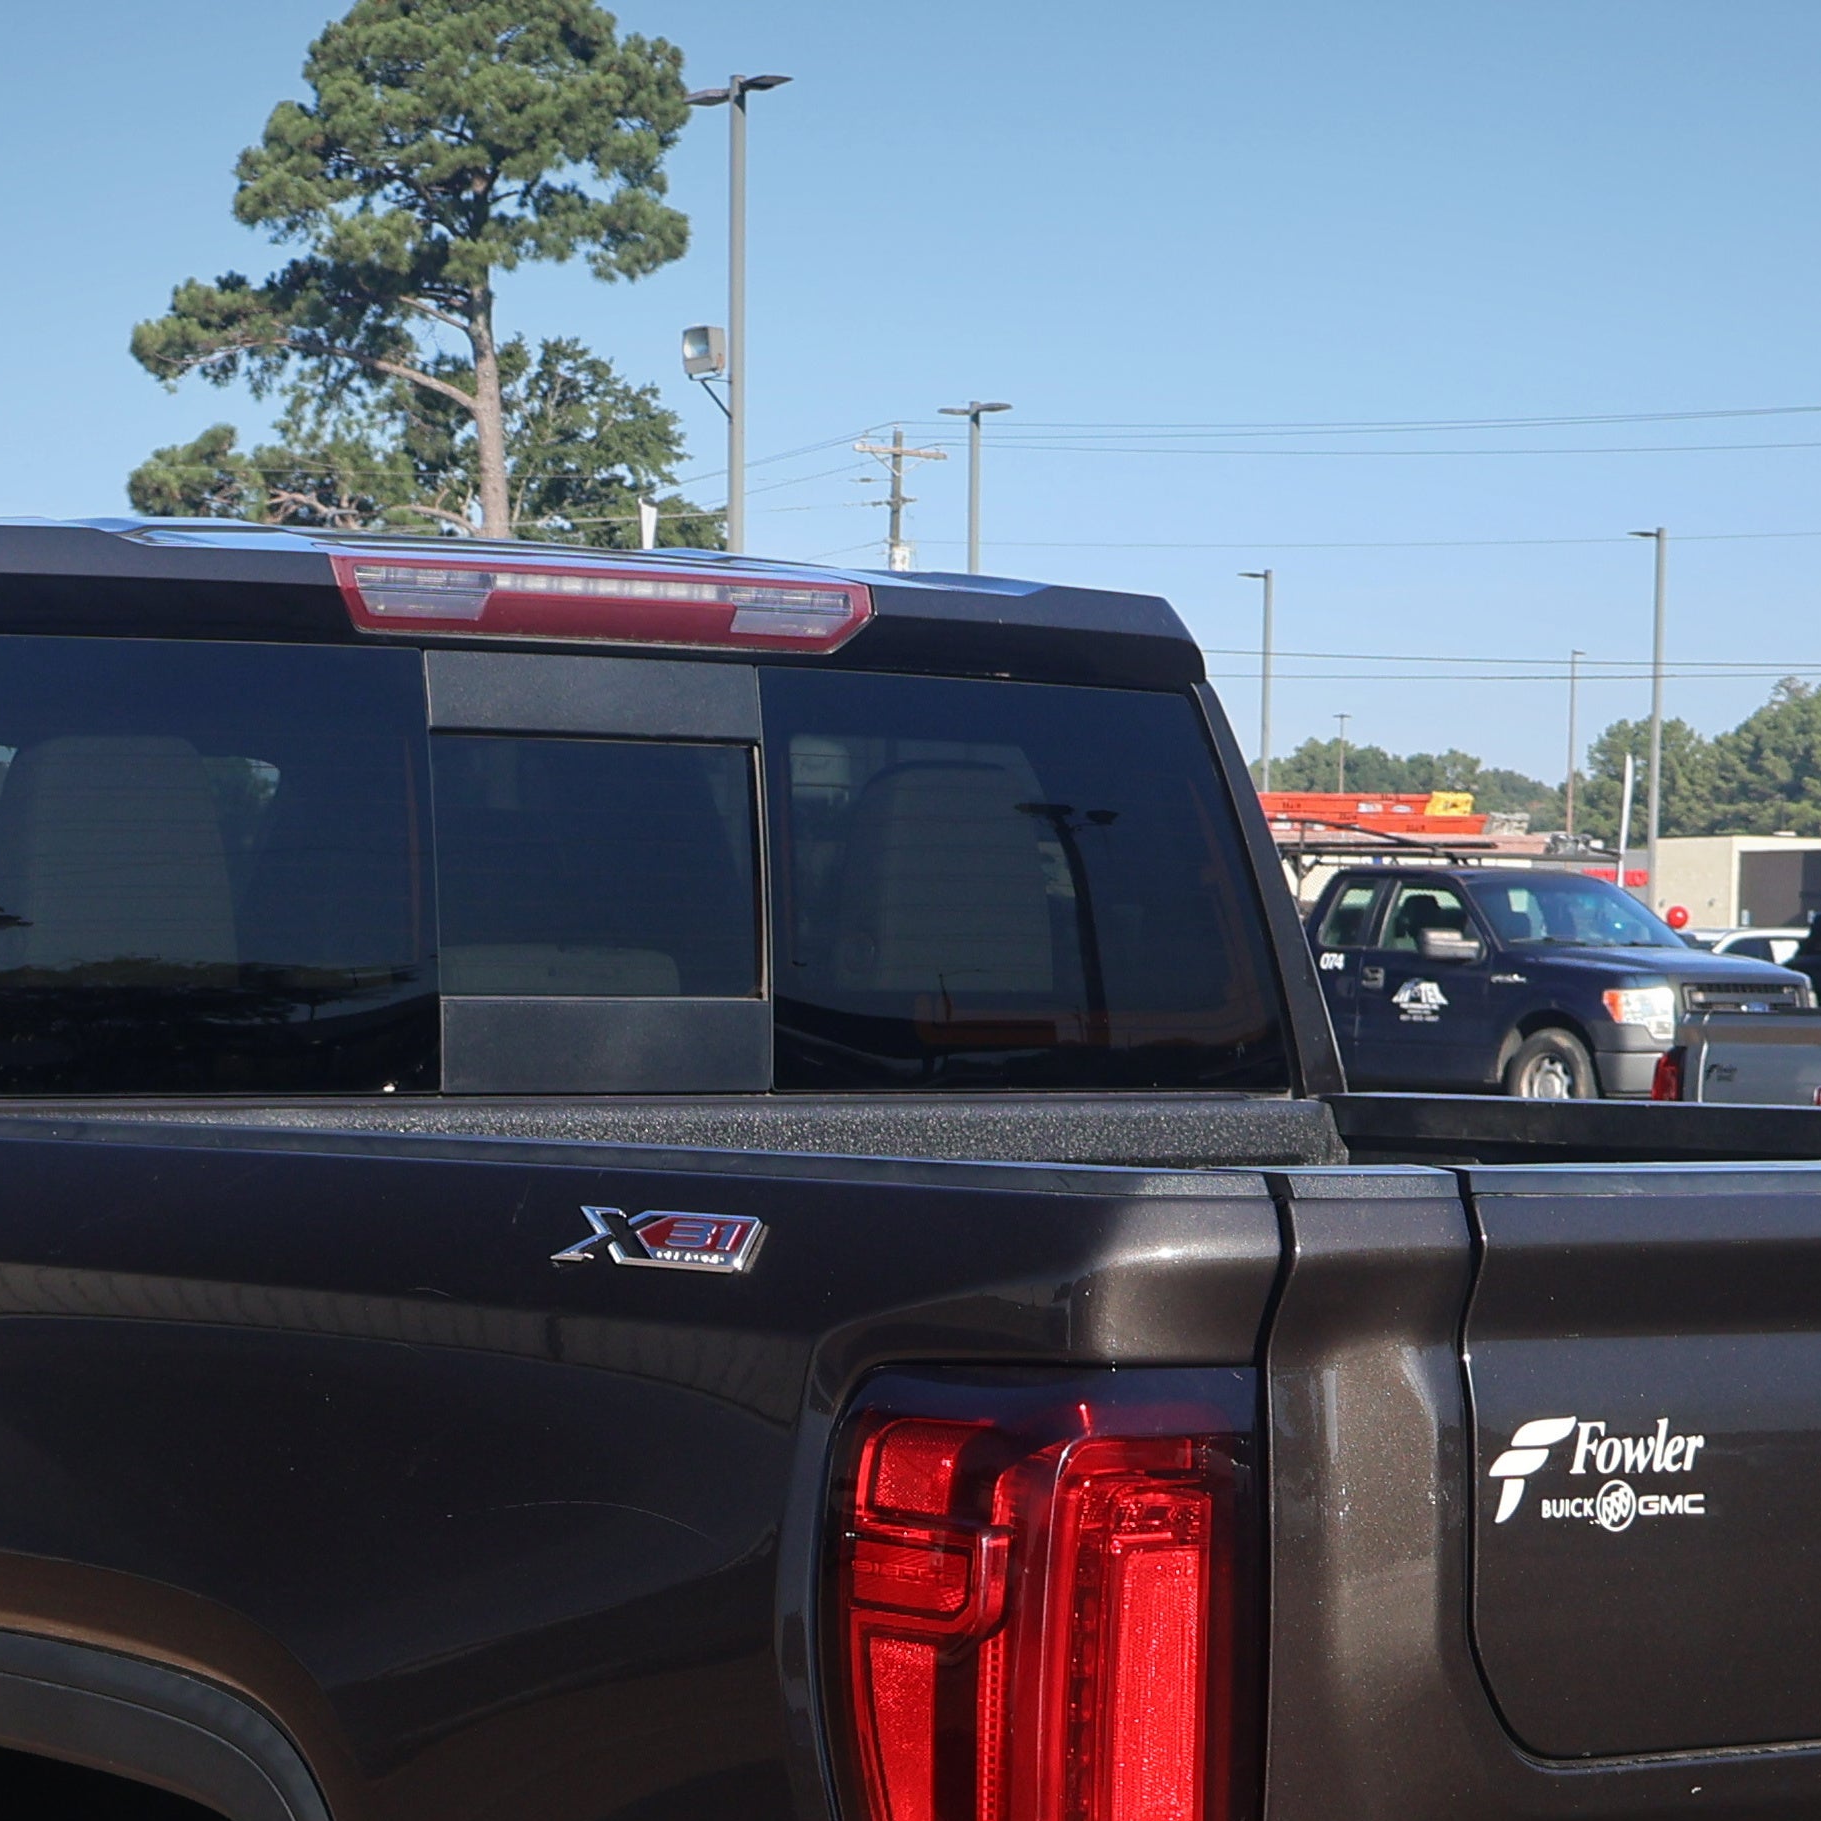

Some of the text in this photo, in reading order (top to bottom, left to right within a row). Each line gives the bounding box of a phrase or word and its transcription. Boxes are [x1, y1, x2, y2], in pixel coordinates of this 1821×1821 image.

[1319, 952, 1345, 970] 074
[1569, 1418, 1705, 1475] Fowler
[1541, 1494, 1705, 1519] BUICK GMC
